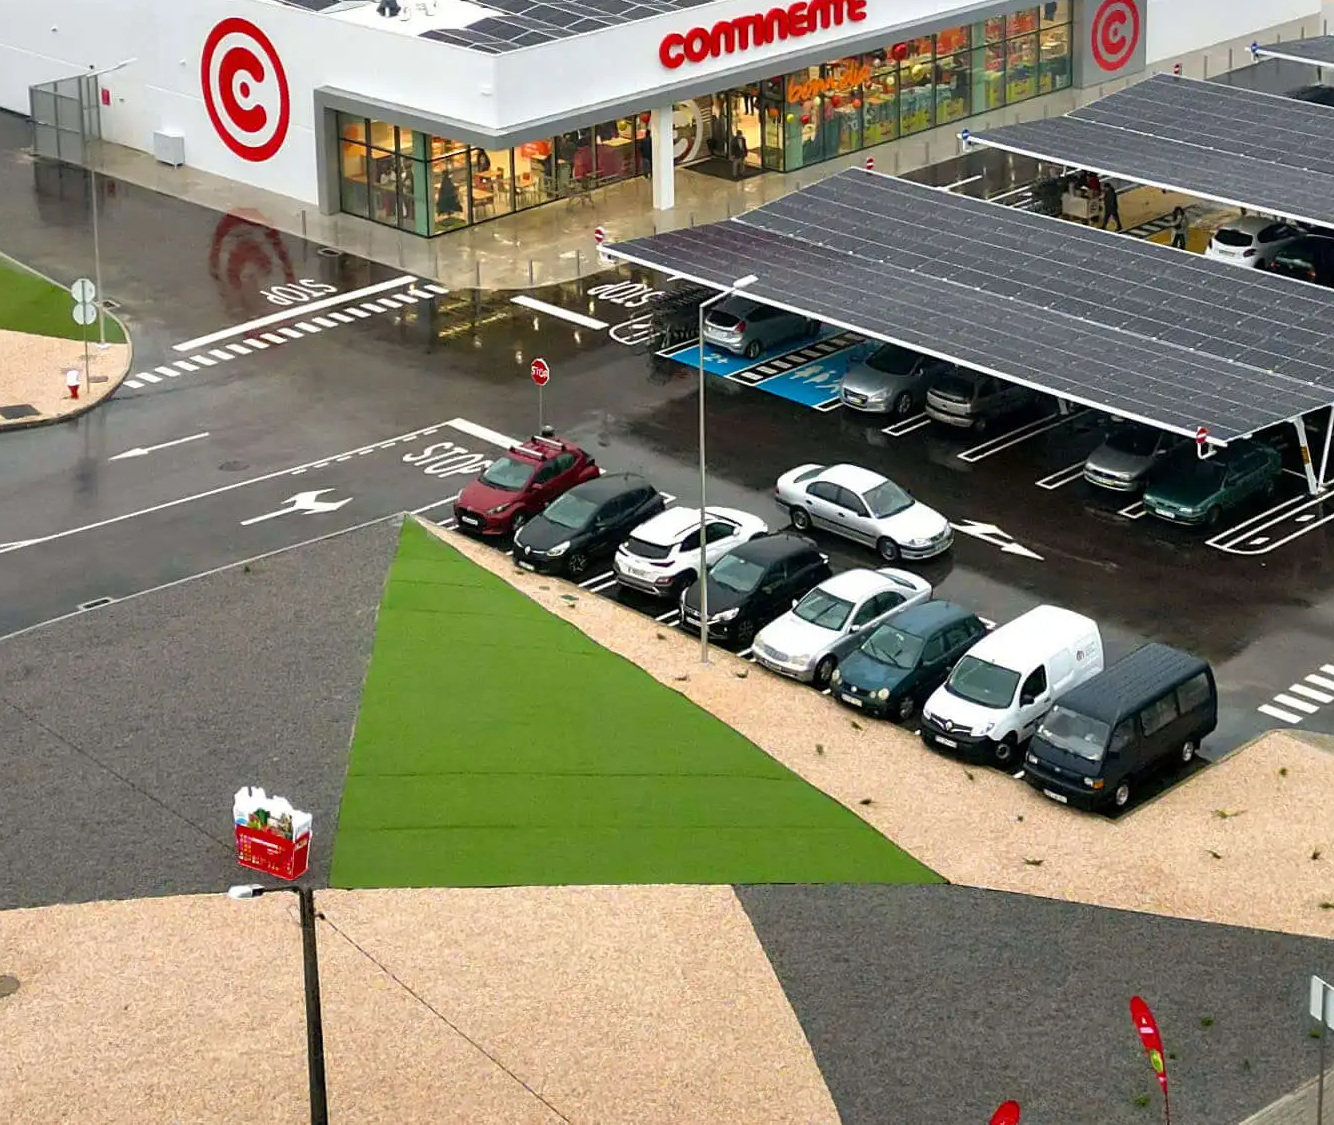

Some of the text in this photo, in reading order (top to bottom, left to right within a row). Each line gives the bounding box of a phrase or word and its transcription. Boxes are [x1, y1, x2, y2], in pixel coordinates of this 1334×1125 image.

[260, 279, 338, 306] STOP
[587, 280, 665, 307] STOP
[531, 365, 549, 379] STOP
